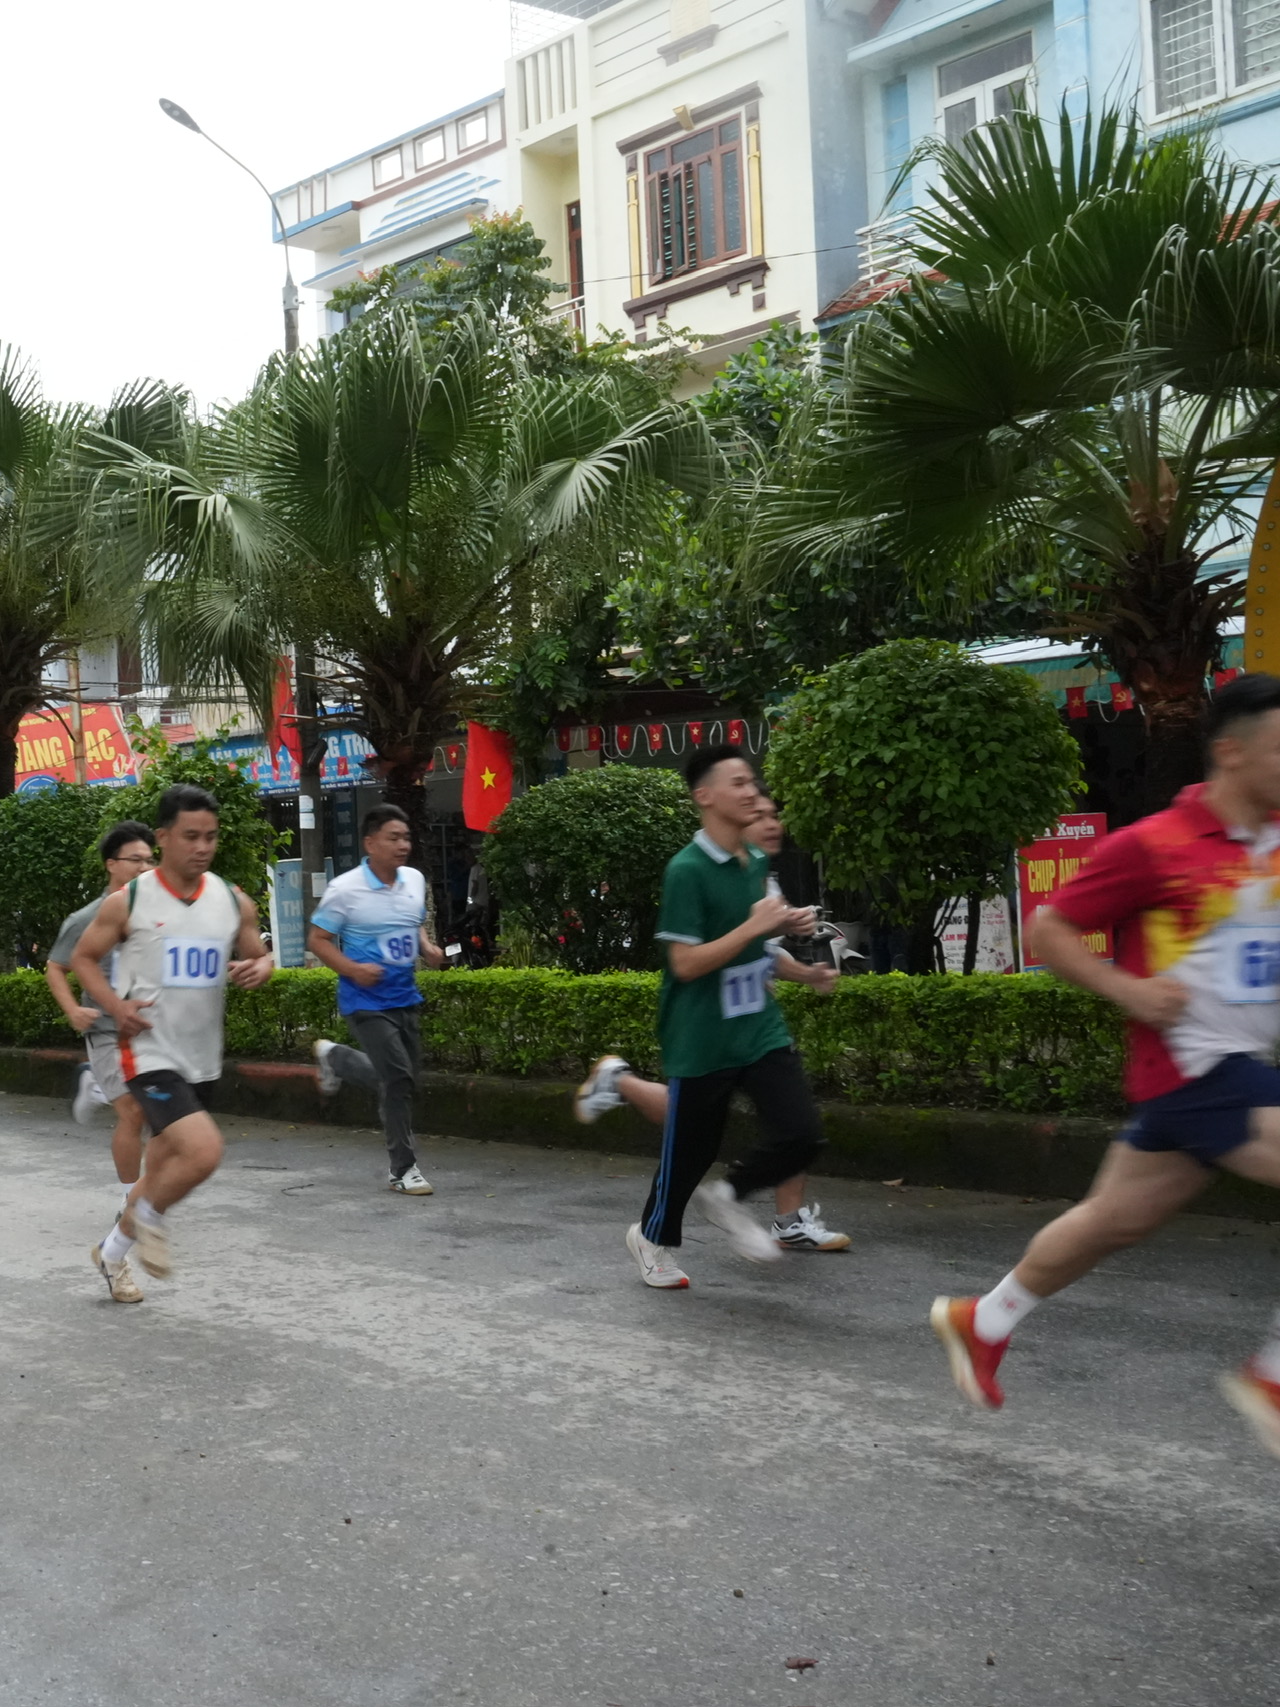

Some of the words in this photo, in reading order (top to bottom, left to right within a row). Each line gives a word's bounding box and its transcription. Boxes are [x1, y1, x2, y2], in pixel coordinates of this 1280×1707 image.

[68, 727, 116, 770] ẠC
[167, 946, 219, 978] 100
[388, 934, 413, 960] 86
